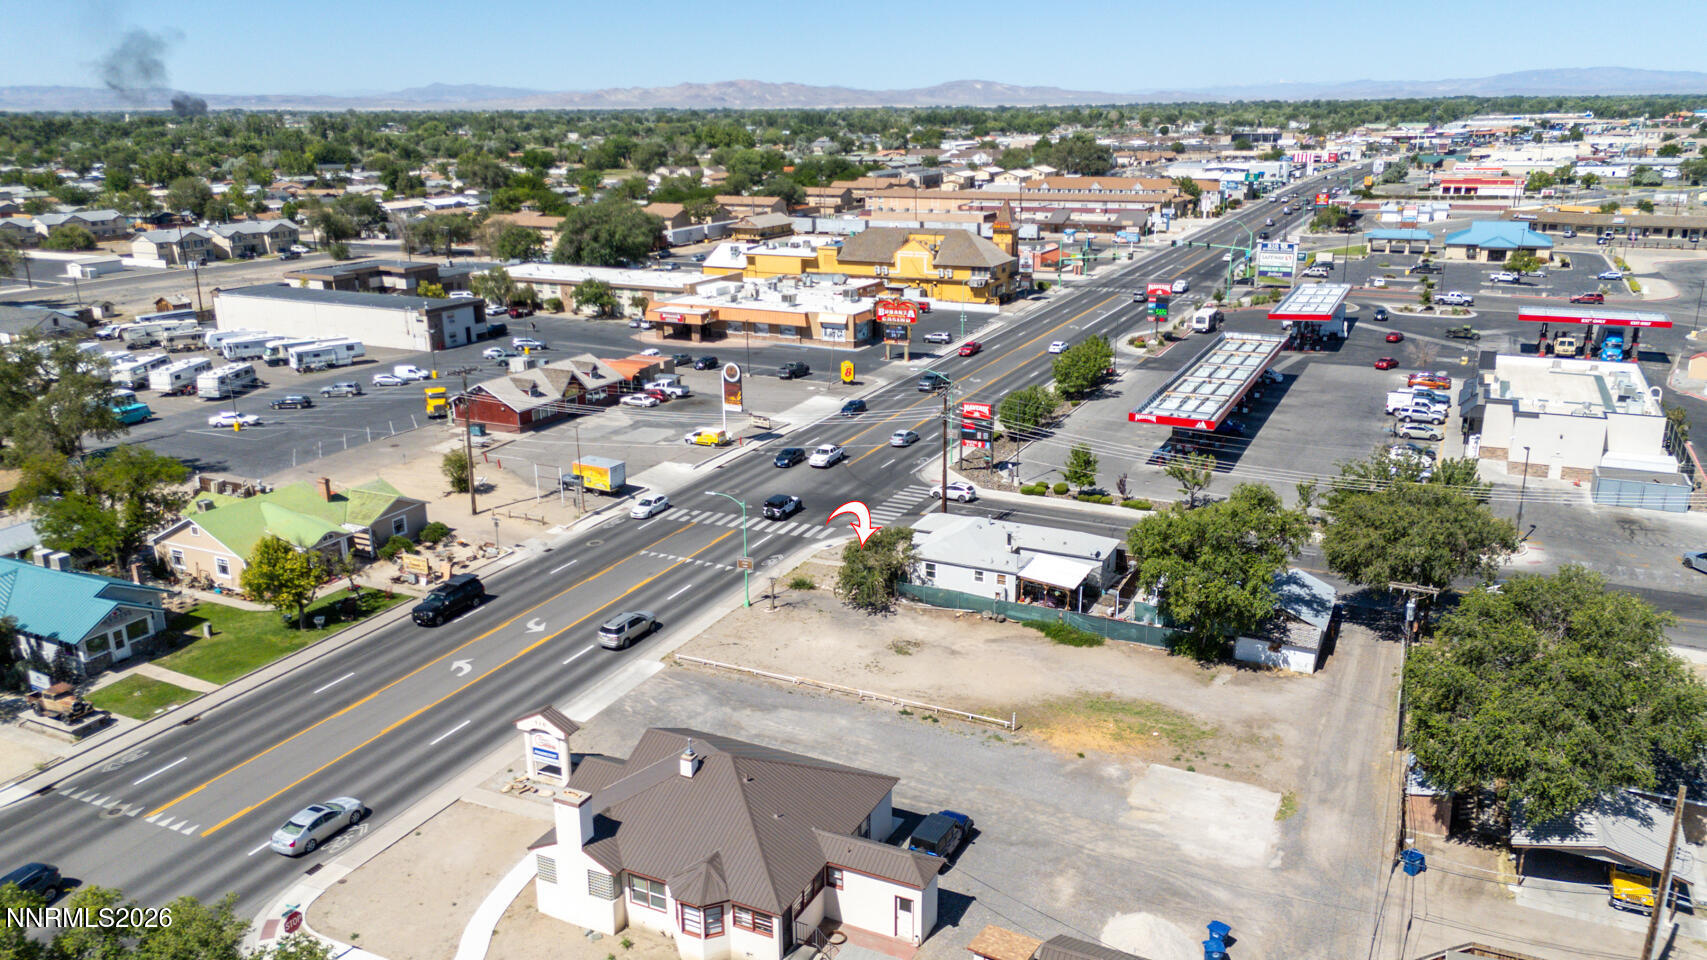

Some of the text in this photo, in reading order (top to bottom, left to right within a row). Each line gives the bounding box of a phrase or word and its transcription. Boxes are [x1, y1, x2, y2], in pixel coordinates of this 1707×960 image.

[1148, 284, 1171, 292] MAVERIK
[878, 307, 916, 318] BONANZA
[844, 367, 852, 377] 8
[964, 404, 990, 416] MAVERIK
[1135, 413, 1157, 423] MAVERIK
[284, 914, 302, 931] STOP
